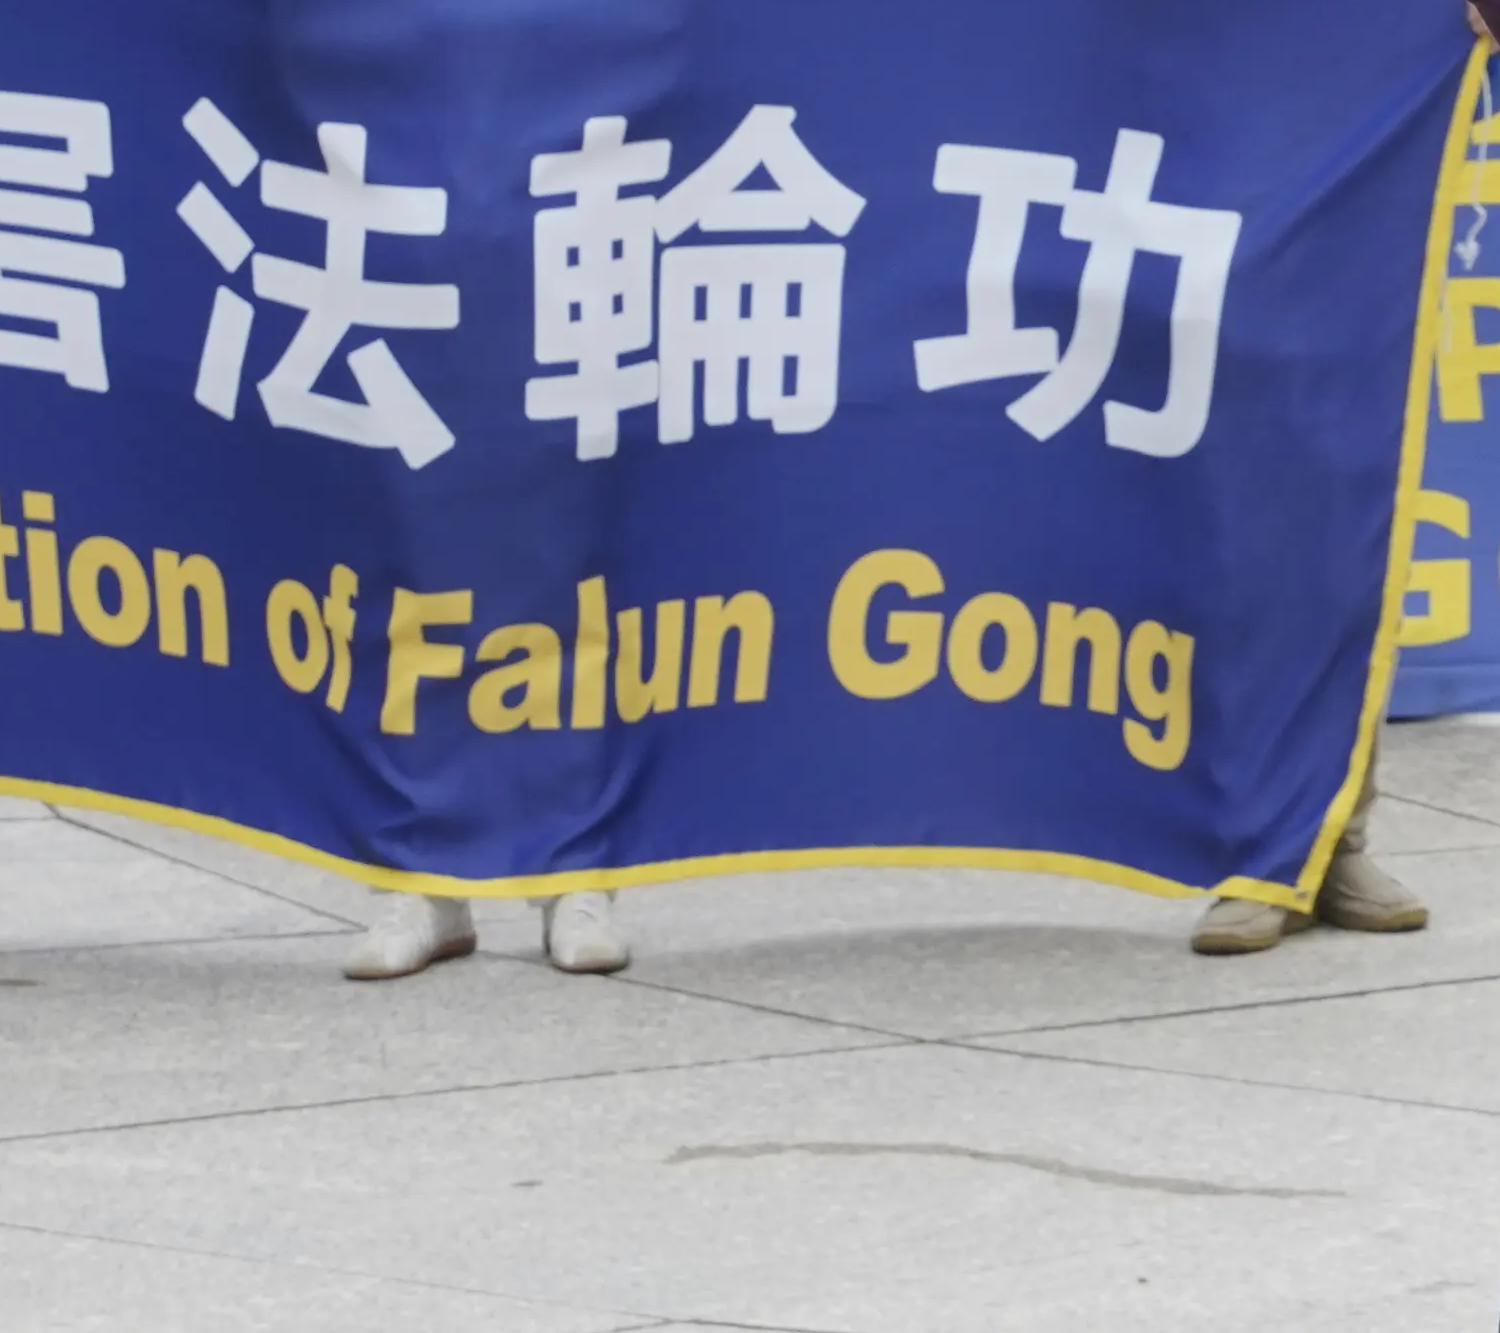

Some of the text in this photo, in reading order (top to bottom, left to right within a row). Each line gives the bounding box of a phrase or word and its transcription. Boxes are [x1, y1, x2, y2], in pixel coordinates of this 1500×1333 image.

[266, 564, 358, 713] of
[380, 575, 774, 735] Falun
[827, 548, 1196, 771] Gong
